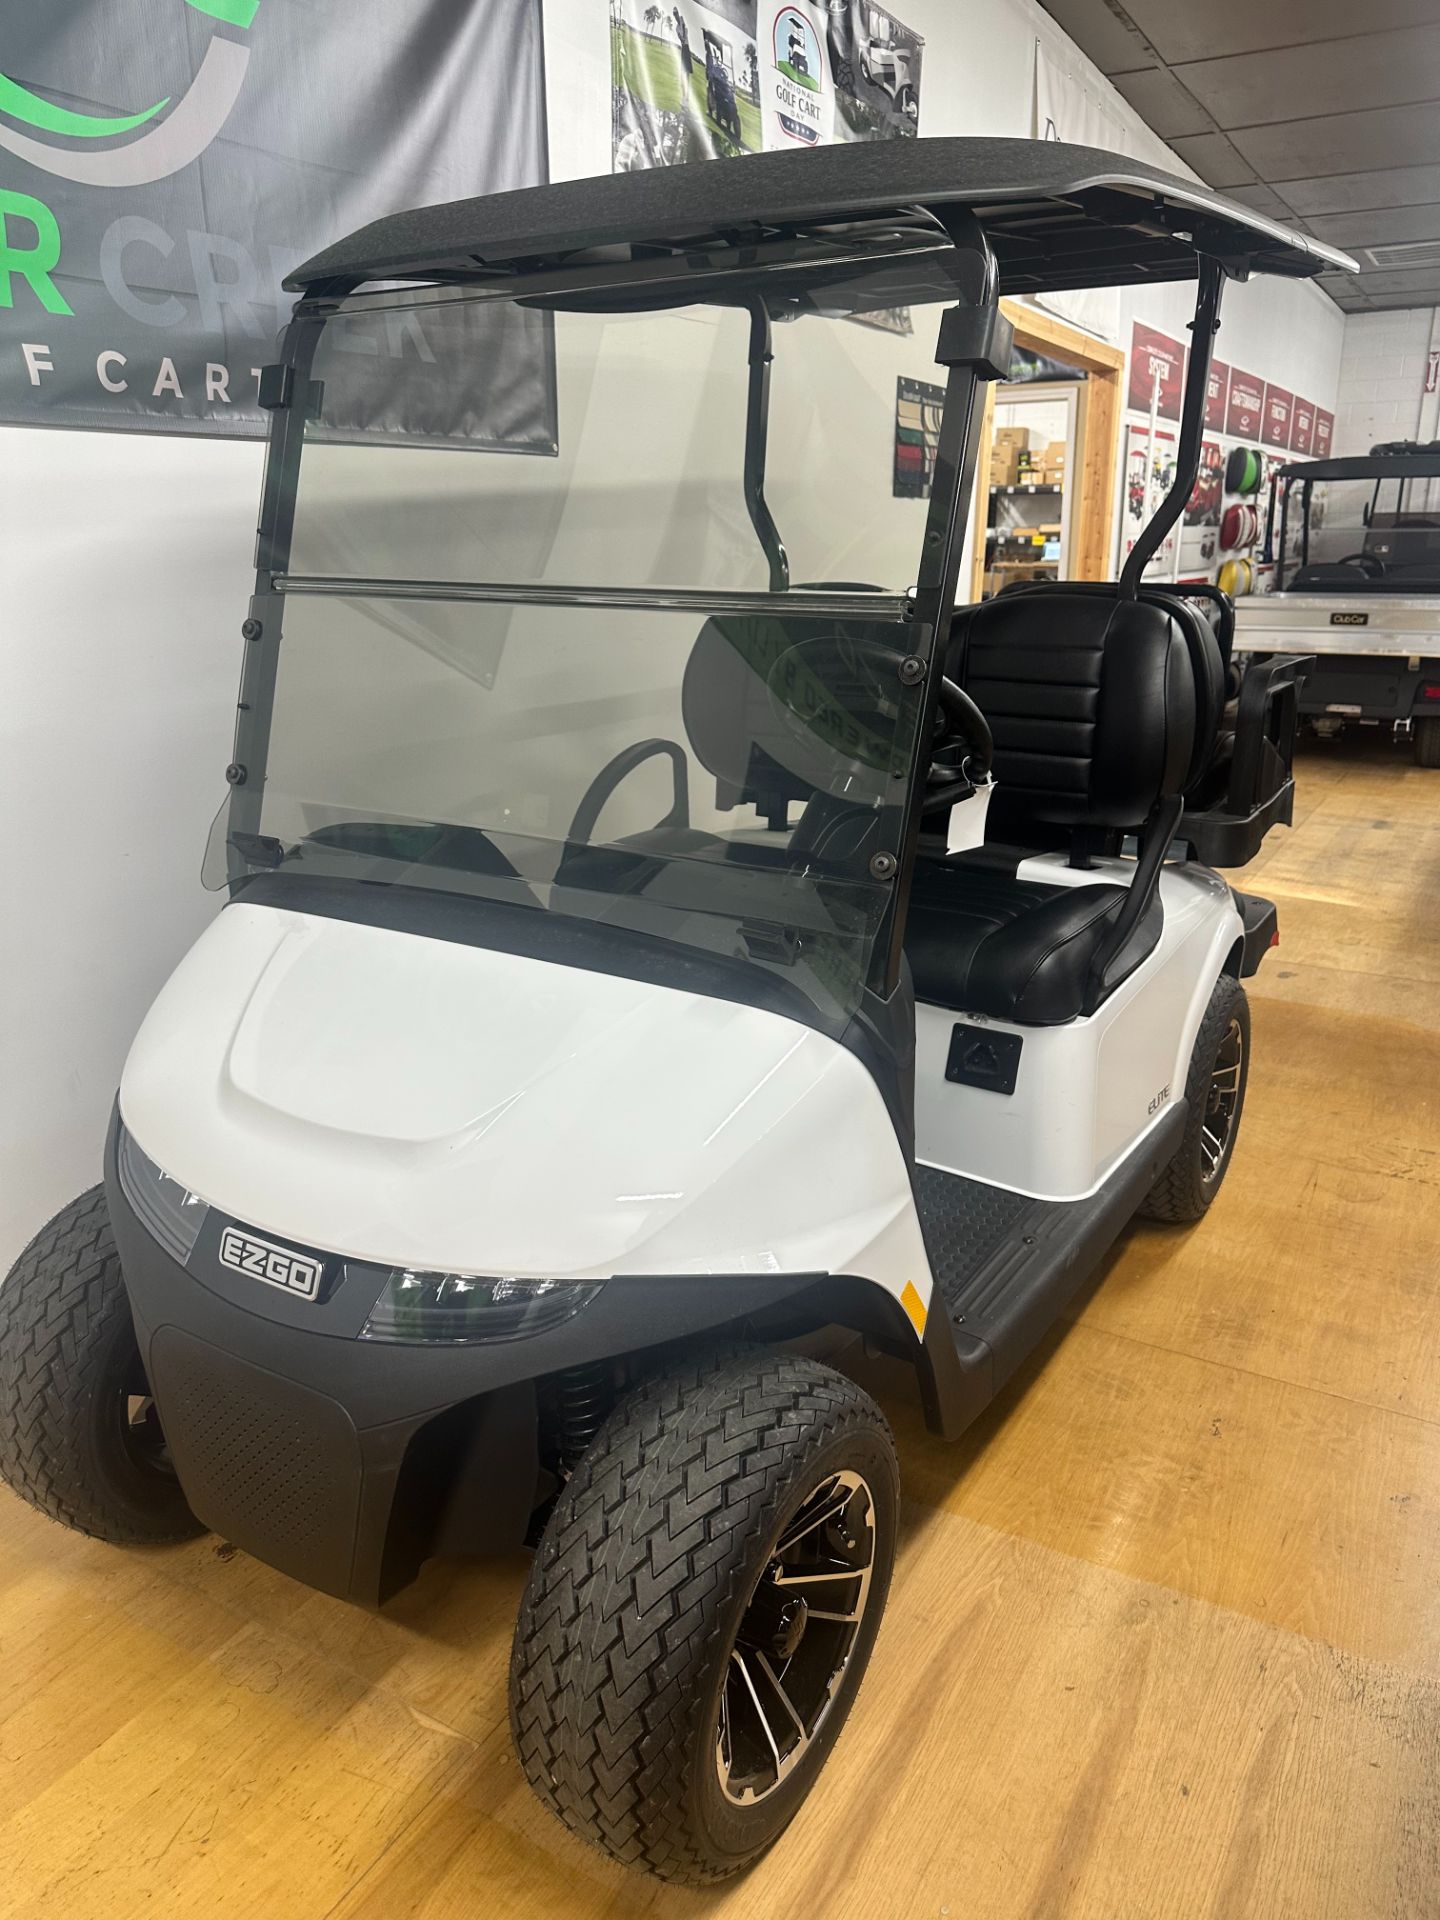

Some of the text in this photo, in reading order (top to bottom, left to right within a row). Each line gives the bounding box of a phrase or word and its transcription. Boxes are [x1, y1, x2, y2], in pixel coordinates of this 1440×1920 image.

[776, 84, 821, 120] GOLF CART
[782, 78, 815, 101] NATIONAL
[791, 110, 805, 121] DAY
[1148, 1083, 1171, 1115] ELITE
[223, 1234, 315, 1293] EZGO
